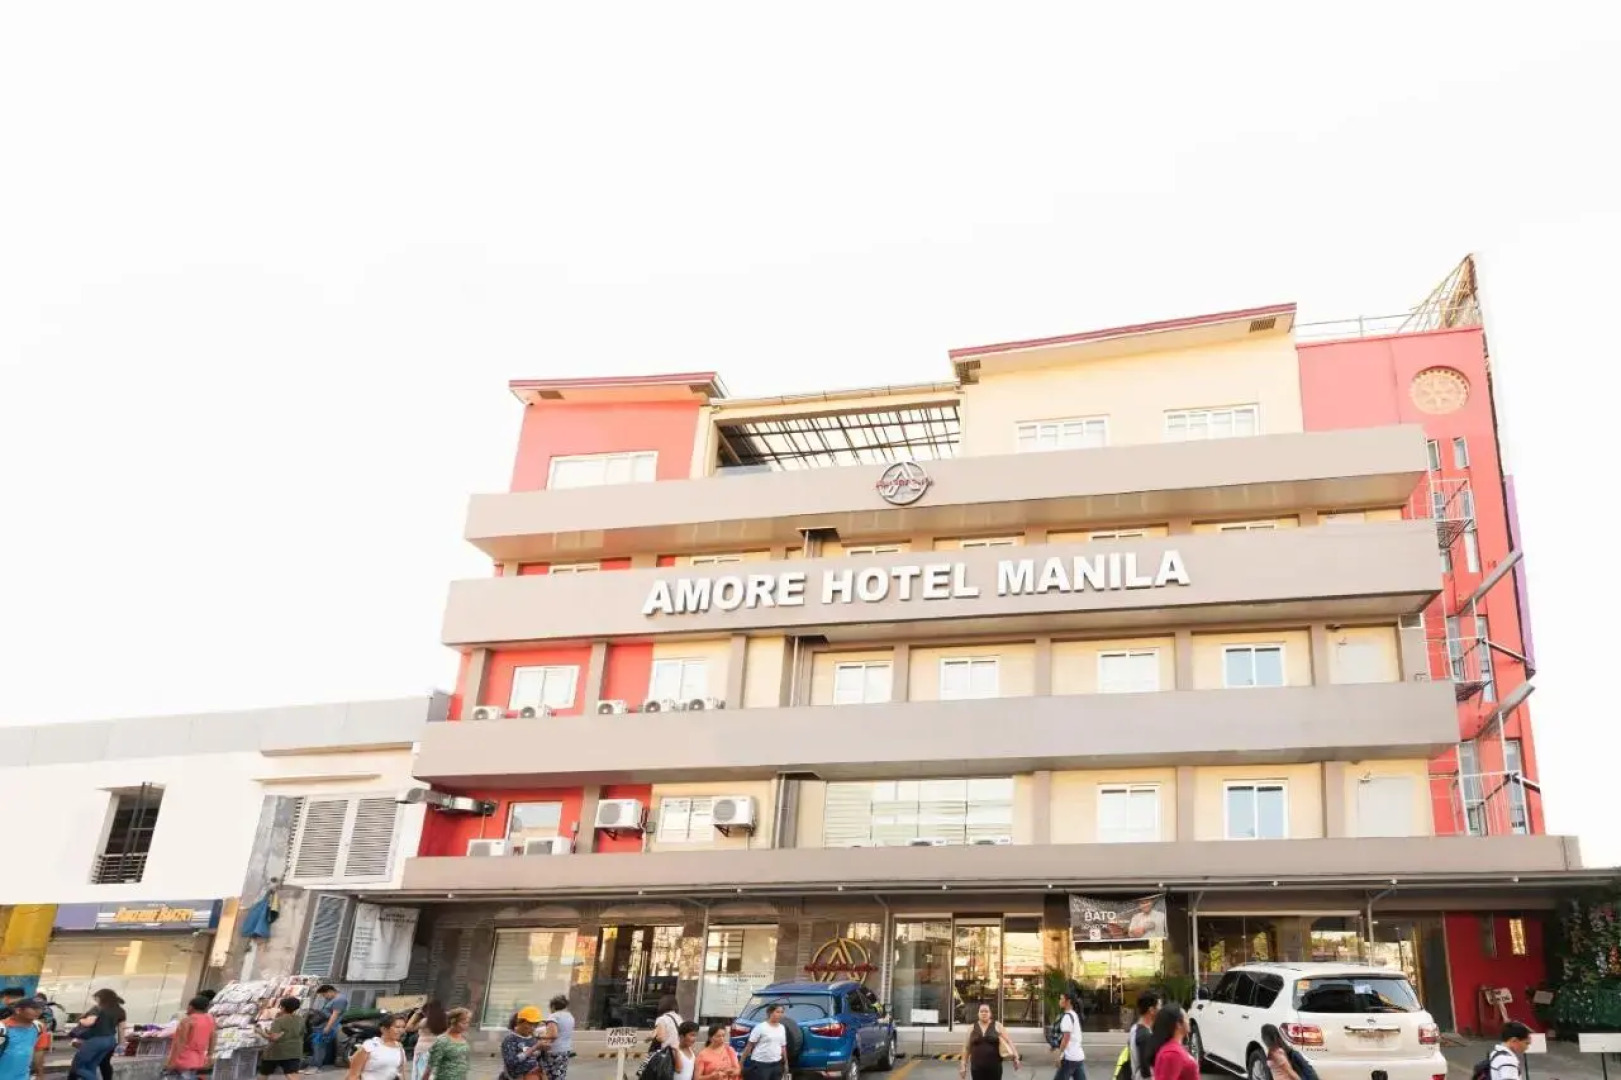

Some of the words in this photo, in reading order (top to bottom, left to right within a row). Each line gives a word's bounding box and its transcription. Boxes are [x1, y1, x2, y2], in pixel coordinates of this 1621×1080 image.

[642, 572, 806, 616] AMORE
[821, 562, 981, 605] HOTEL
[998, 549, 1191, 597] MANILA
[1084, 911, 1117, 922] BATO
